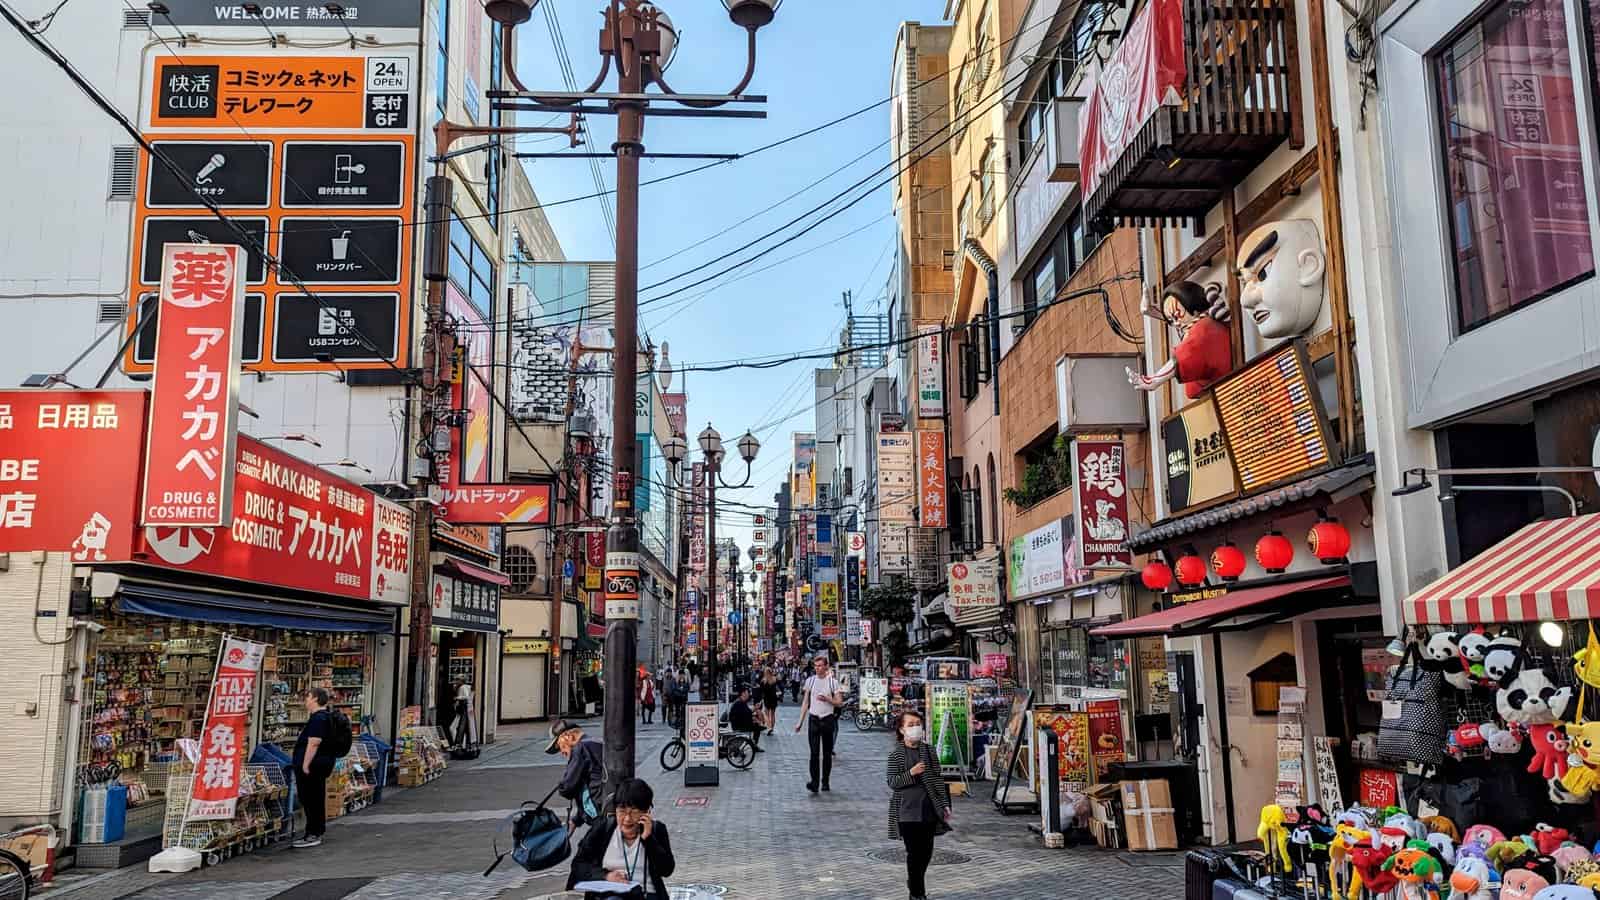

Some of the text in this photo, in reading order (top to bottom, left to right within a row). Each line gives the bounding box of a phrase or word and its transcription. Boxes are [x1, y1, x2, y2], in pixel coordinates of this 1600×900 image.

[169, 74, 211, 93] 快活
[373, 78, 402, 87] OPEN
[168, 95, 209, 109] CLUB
[224, 97, 313, 114] テレワーク
[371, 96, 402, 111] 受付
[375, 112, 399, 127] 6F
[171, 252, 228, 301] 薬
[315, 263, 363, 272] ドリンクバー
[309, 337, 361, 346] USBコンセン
[175, 327, 225, 481] アカカベ
[38, 404, 118, 429] 日用品
[261, 460, 321, 501] AKAKABE
[163, 492, 216, 504] DRUG &
[149, 506, 216, 519] COSMETIC
[245, 491, 284, 524] DRUG &
[232, 517, 283, 551] COSMETIC
[288, 506, 363, 568] アカカベ
[376, 527, 408, 574] 免税
[218, 677, 256, 695] TAX
[202, 724, 236, 789] 免税
